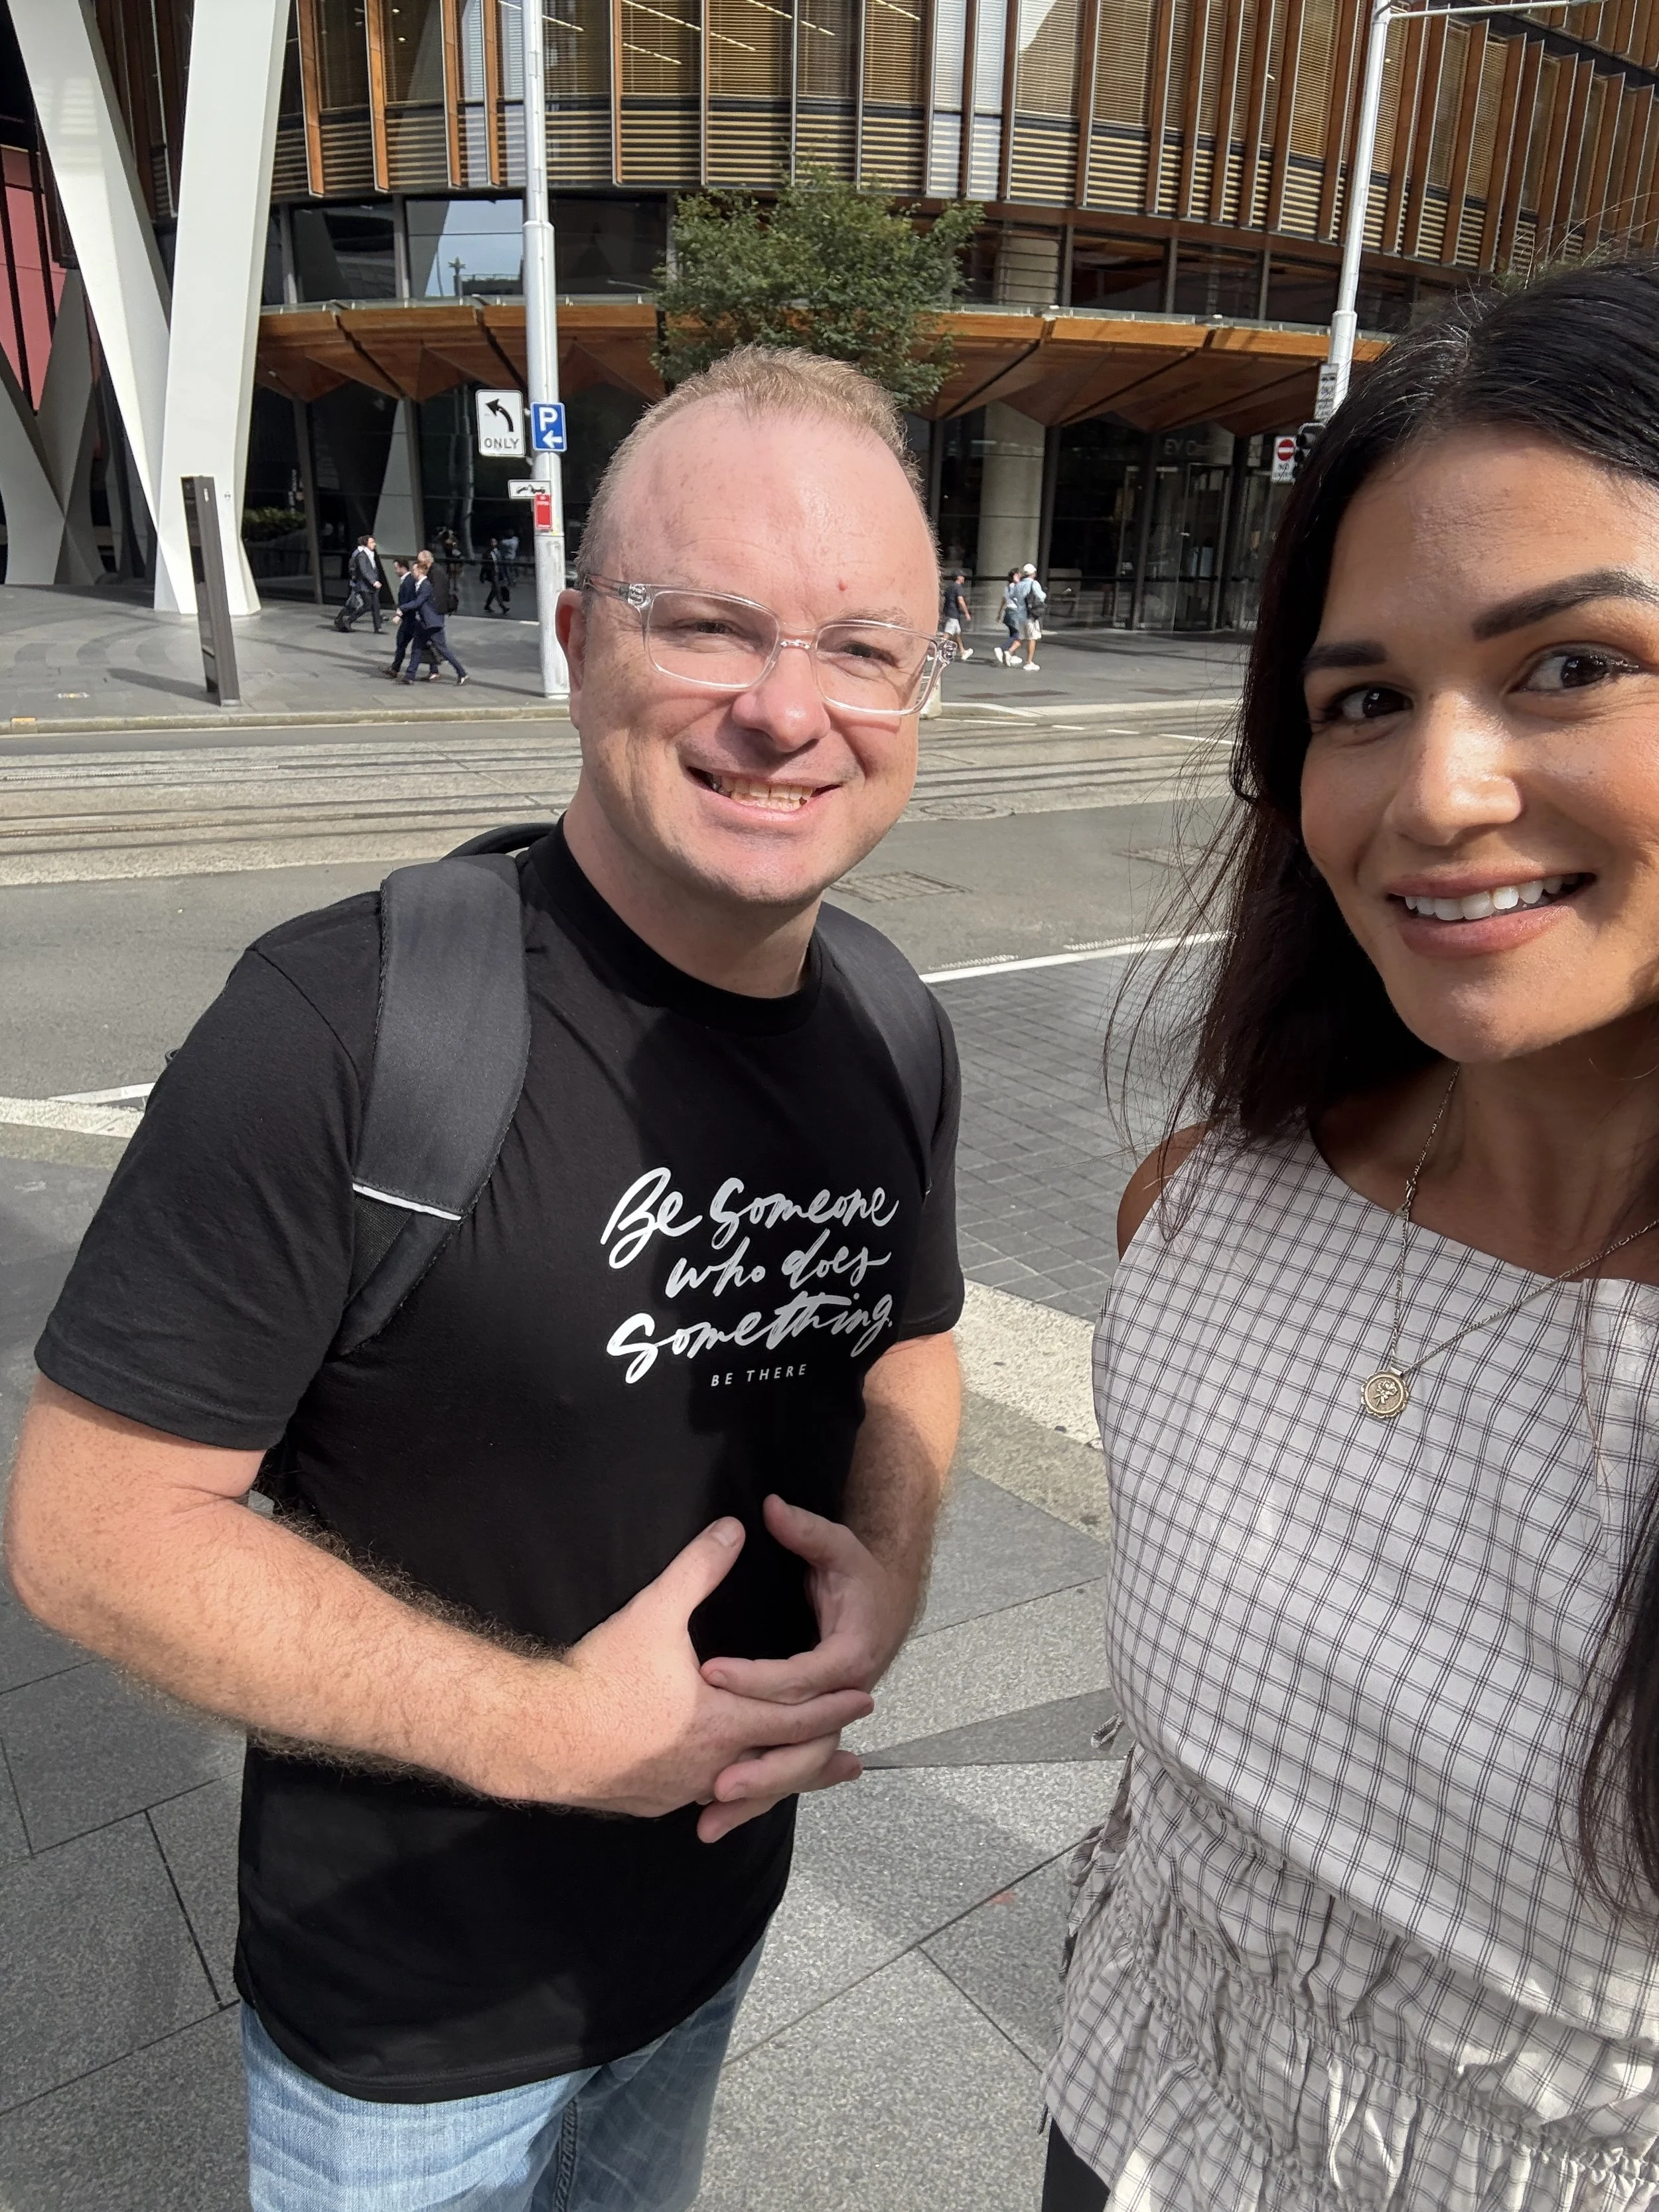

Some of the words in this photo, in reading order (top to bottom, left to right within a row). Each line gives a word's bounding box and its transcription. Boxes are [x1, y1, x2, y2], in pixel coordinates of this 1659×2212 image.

[539, 407, 558, 431] P
[484, 437, 520, 450] ONLY
[599, 1167, 703, 1270] Be
[665, 1236, 766, 1299] who
[781, 1228, 892, 1290] does
[711, 1372, 733, 1387] BE
[747, 1364, 807, 1382] THERE
